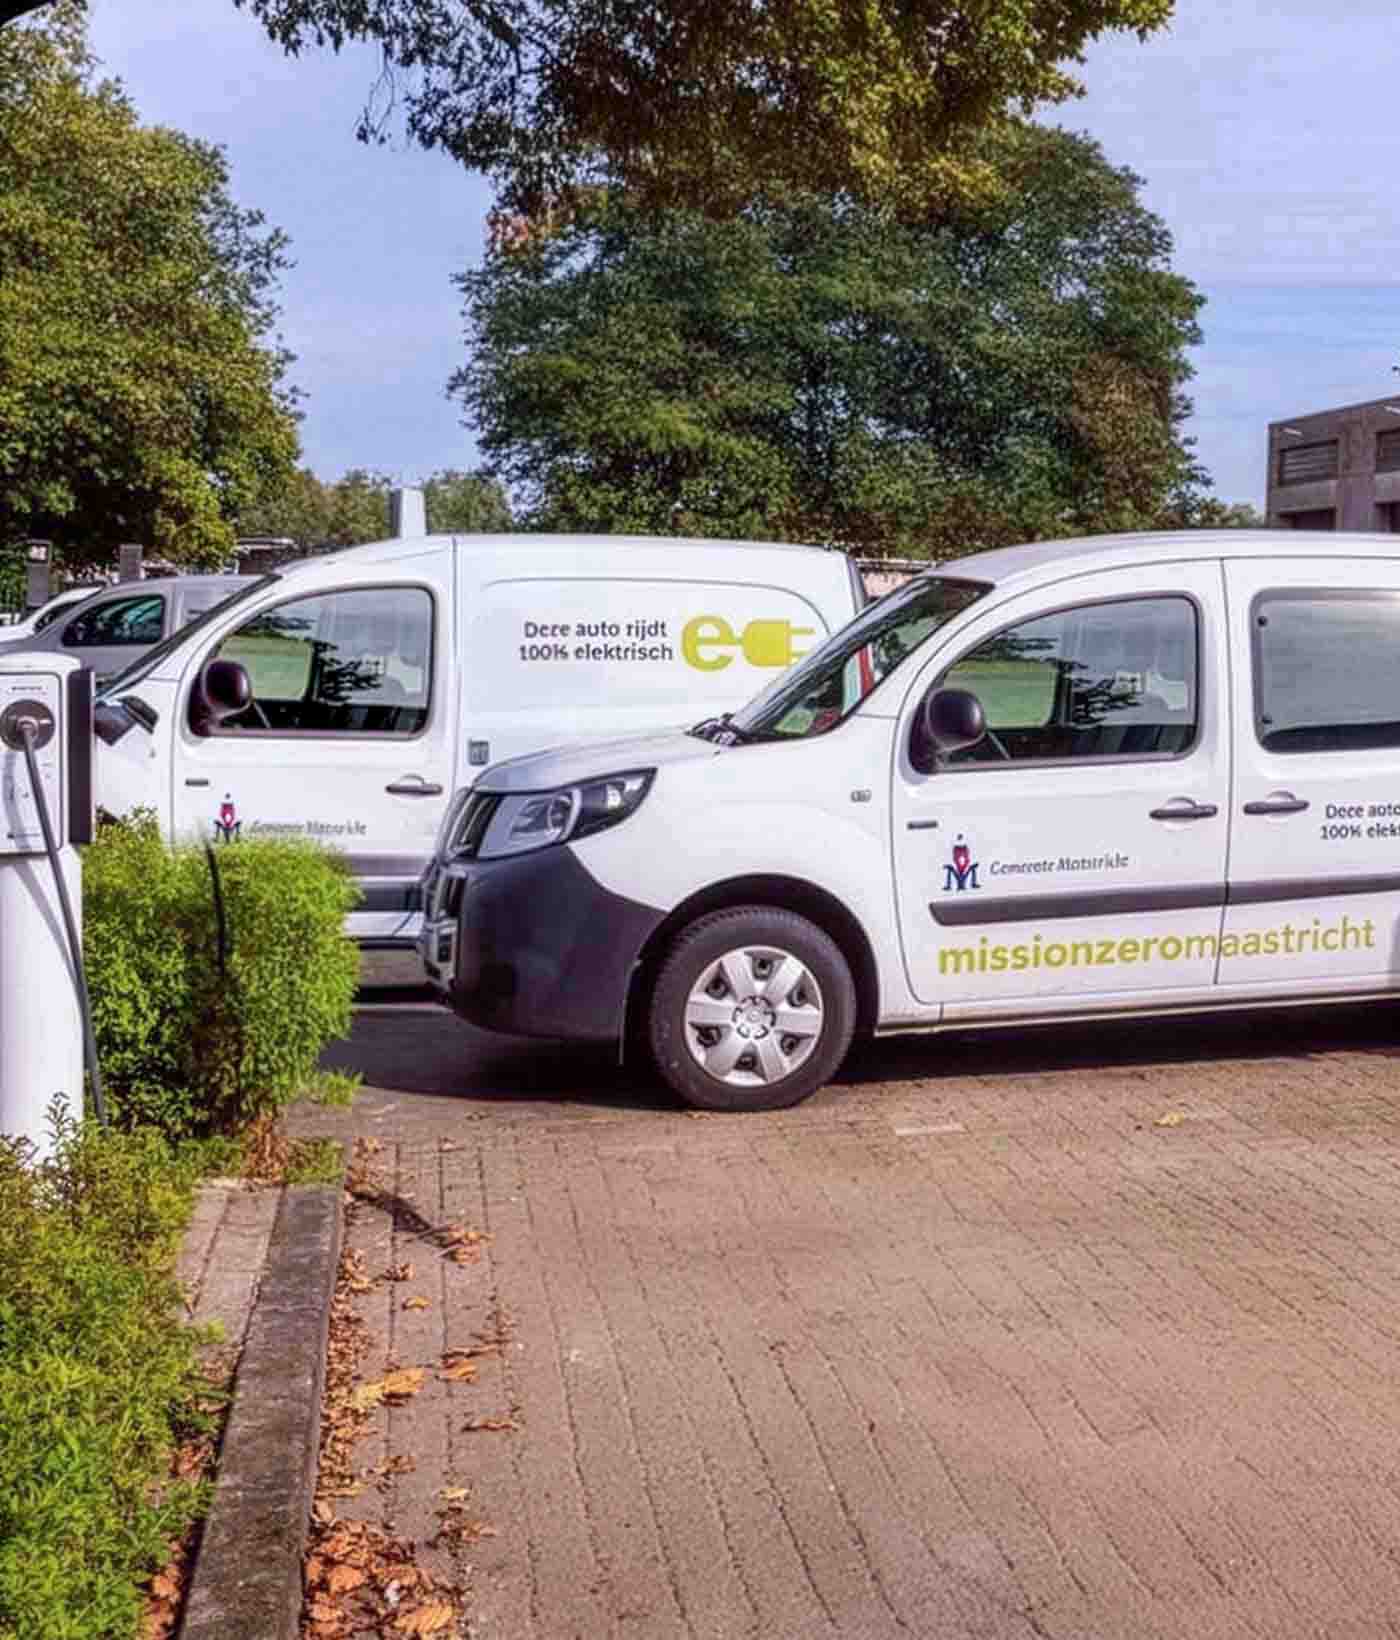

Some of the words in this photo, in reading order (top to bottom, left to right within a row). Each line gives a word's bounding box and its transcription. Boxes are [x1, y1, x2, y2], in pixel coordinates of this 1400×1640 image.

[575, 622, 620, 638] auto
[626, 619, 668, 640] rijdt
[573, 641, 673, 661] elektrisch
[937, 916, 1375, 975] missionzeromaastricht
